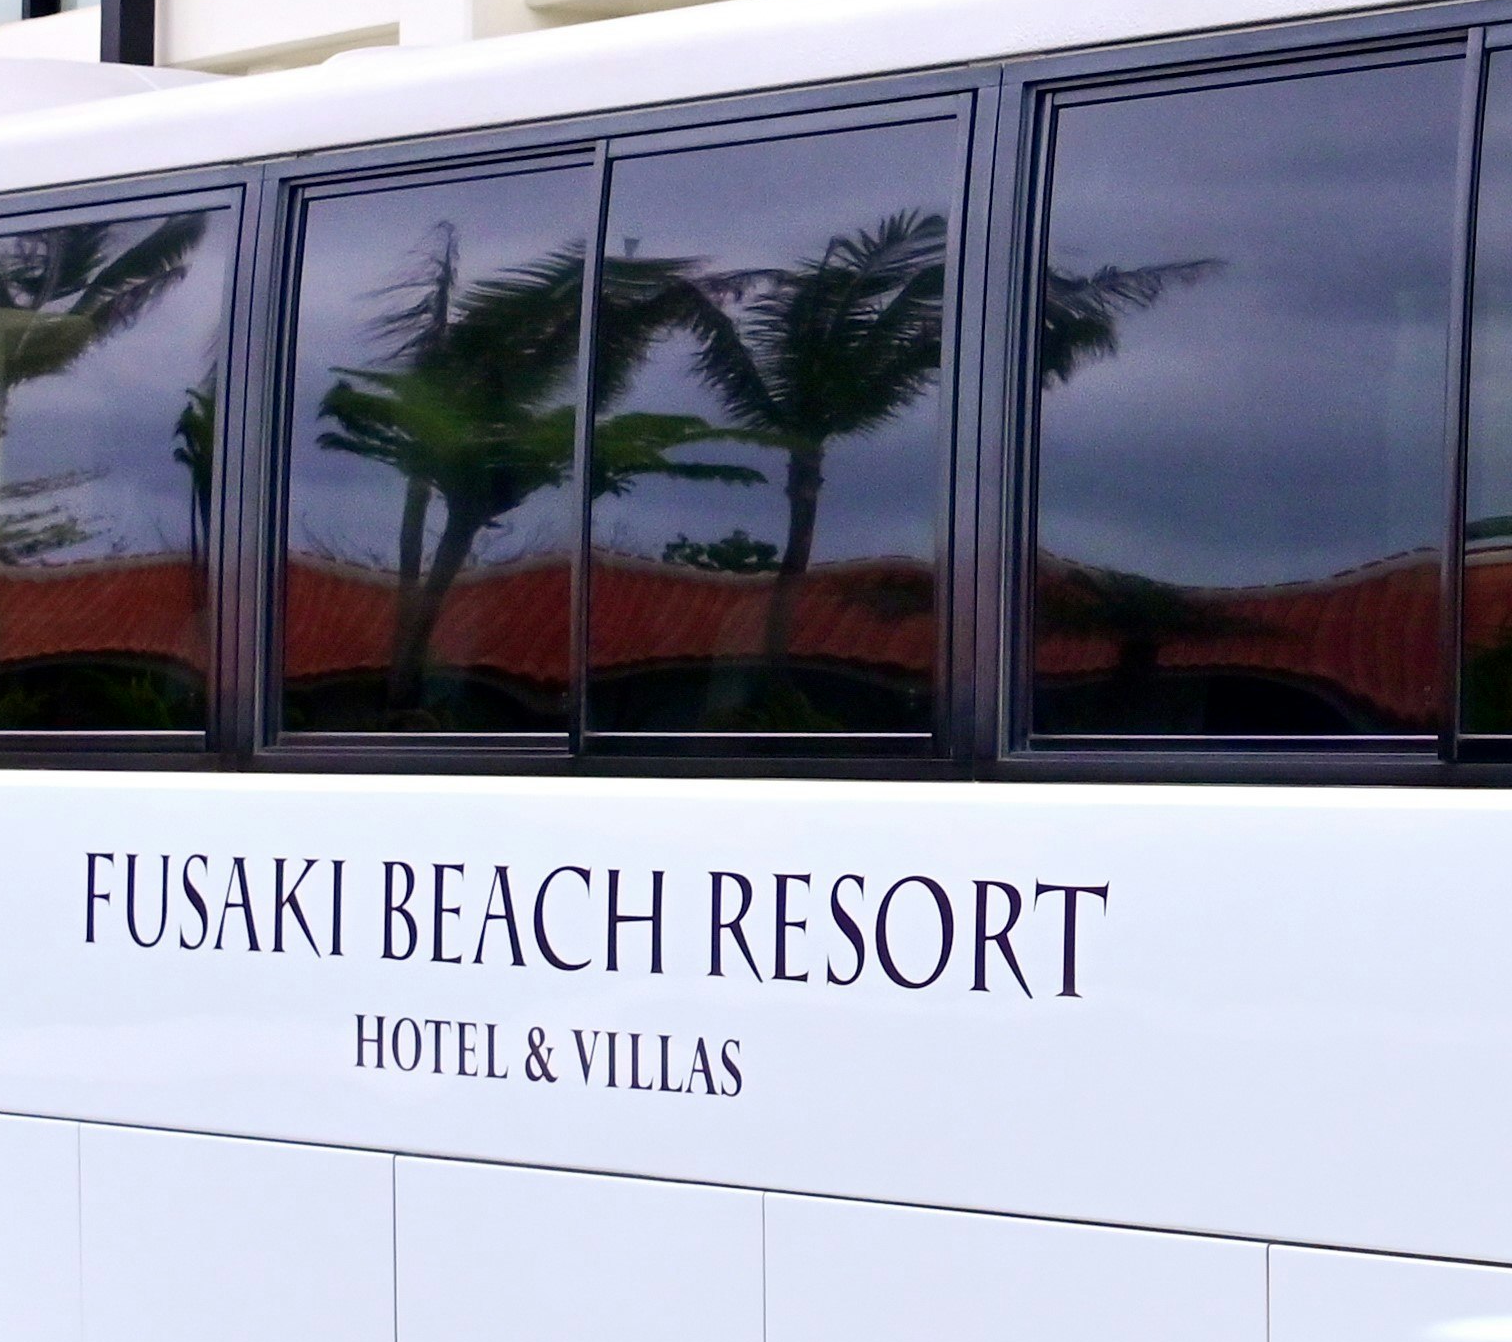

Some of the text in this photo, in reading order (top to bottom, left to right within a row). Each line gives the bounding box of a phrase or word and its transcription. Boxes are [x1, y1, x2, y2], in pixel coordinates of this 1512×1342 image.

[84, 851, 1110, 1000] FUSAKI BEACH RESORT
[354, 1012, 744, 1098] HOTEL & VILLAS
